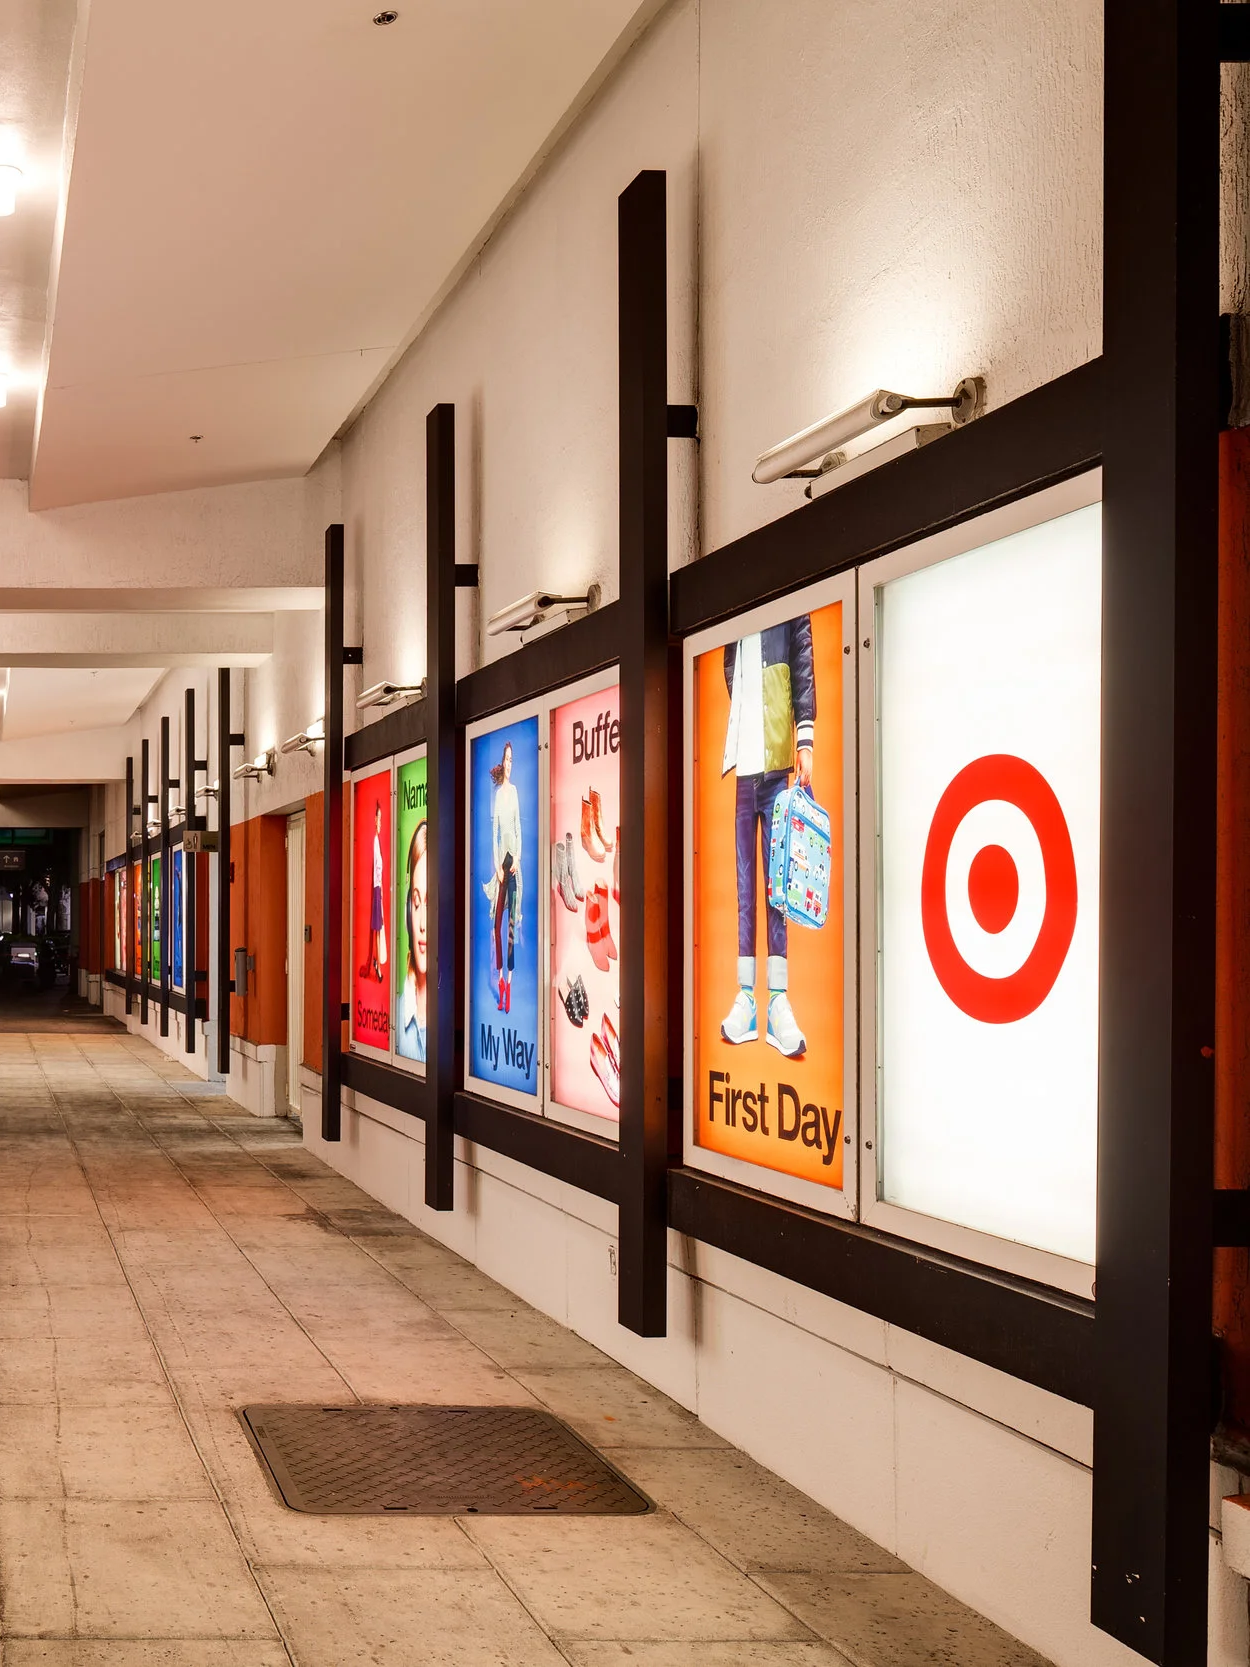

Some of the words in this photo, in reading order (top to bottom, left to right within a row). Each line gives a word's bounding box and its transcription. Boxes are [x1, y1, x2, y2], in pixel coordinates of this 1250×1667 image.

[573, 710, 620, 765] Buffe
[481, 1023, 500, 1071] My
[502, 1027, 535, 1080] Way
[709, 1070, 769, 1136] First
[778, 1082, 842, 1166] Day
